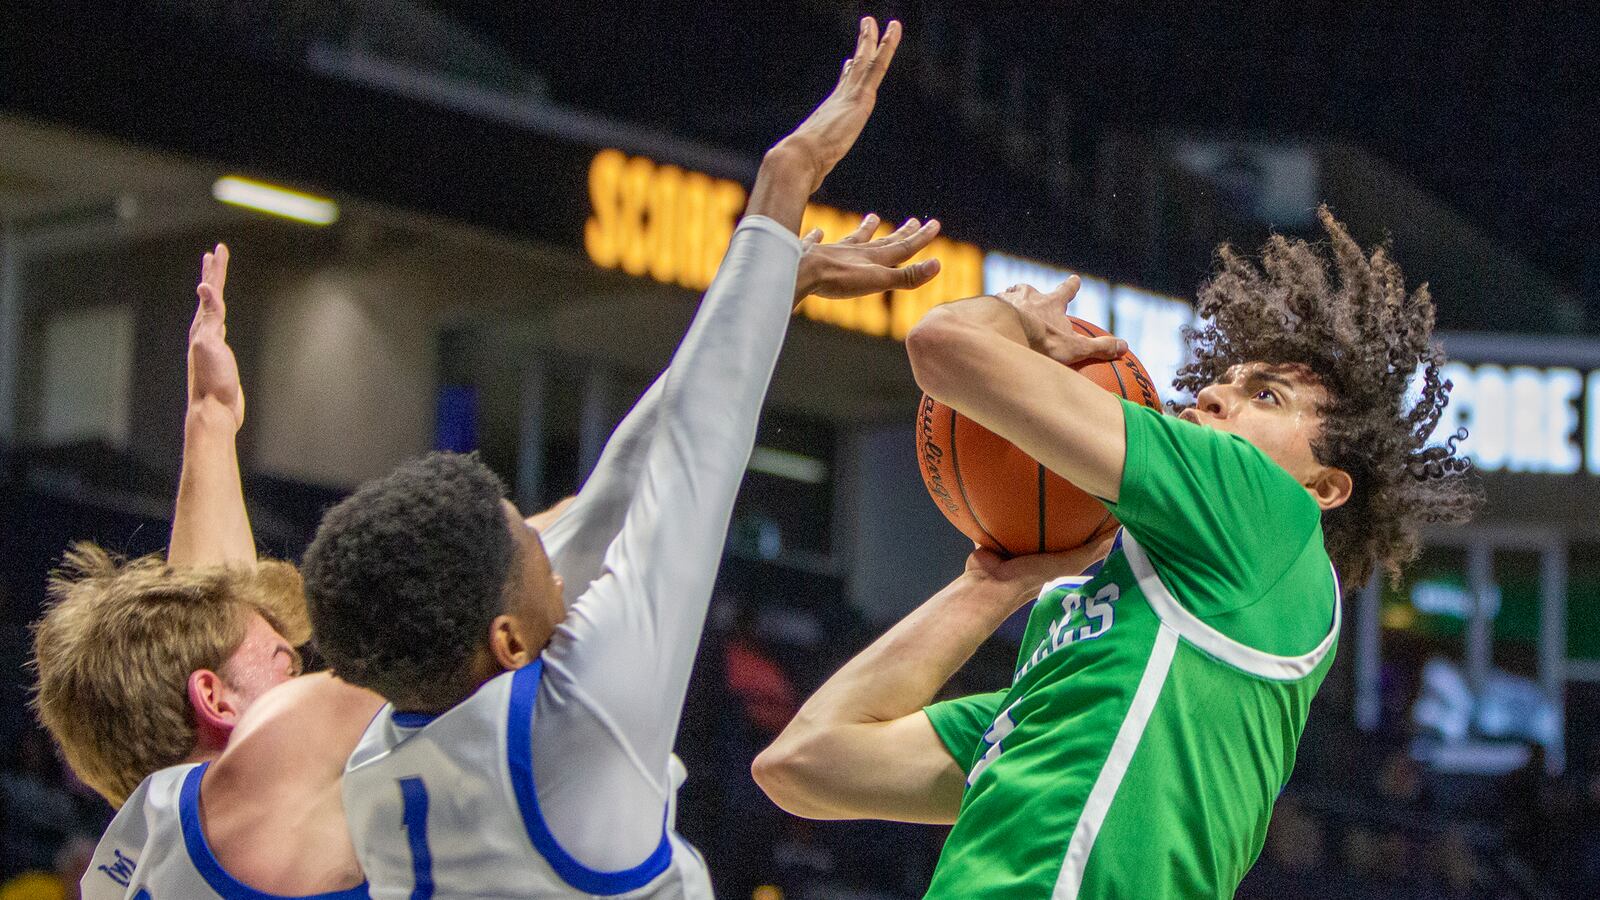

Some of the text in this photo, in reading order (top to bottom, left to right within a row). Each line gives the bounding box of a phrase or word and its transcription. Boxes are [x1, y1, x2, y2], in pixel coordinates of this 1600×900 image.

[921, 394, 959, 513] awlings
[1416, 361, 1583, 475] CORE
[396, 775, 434, 900] 1
